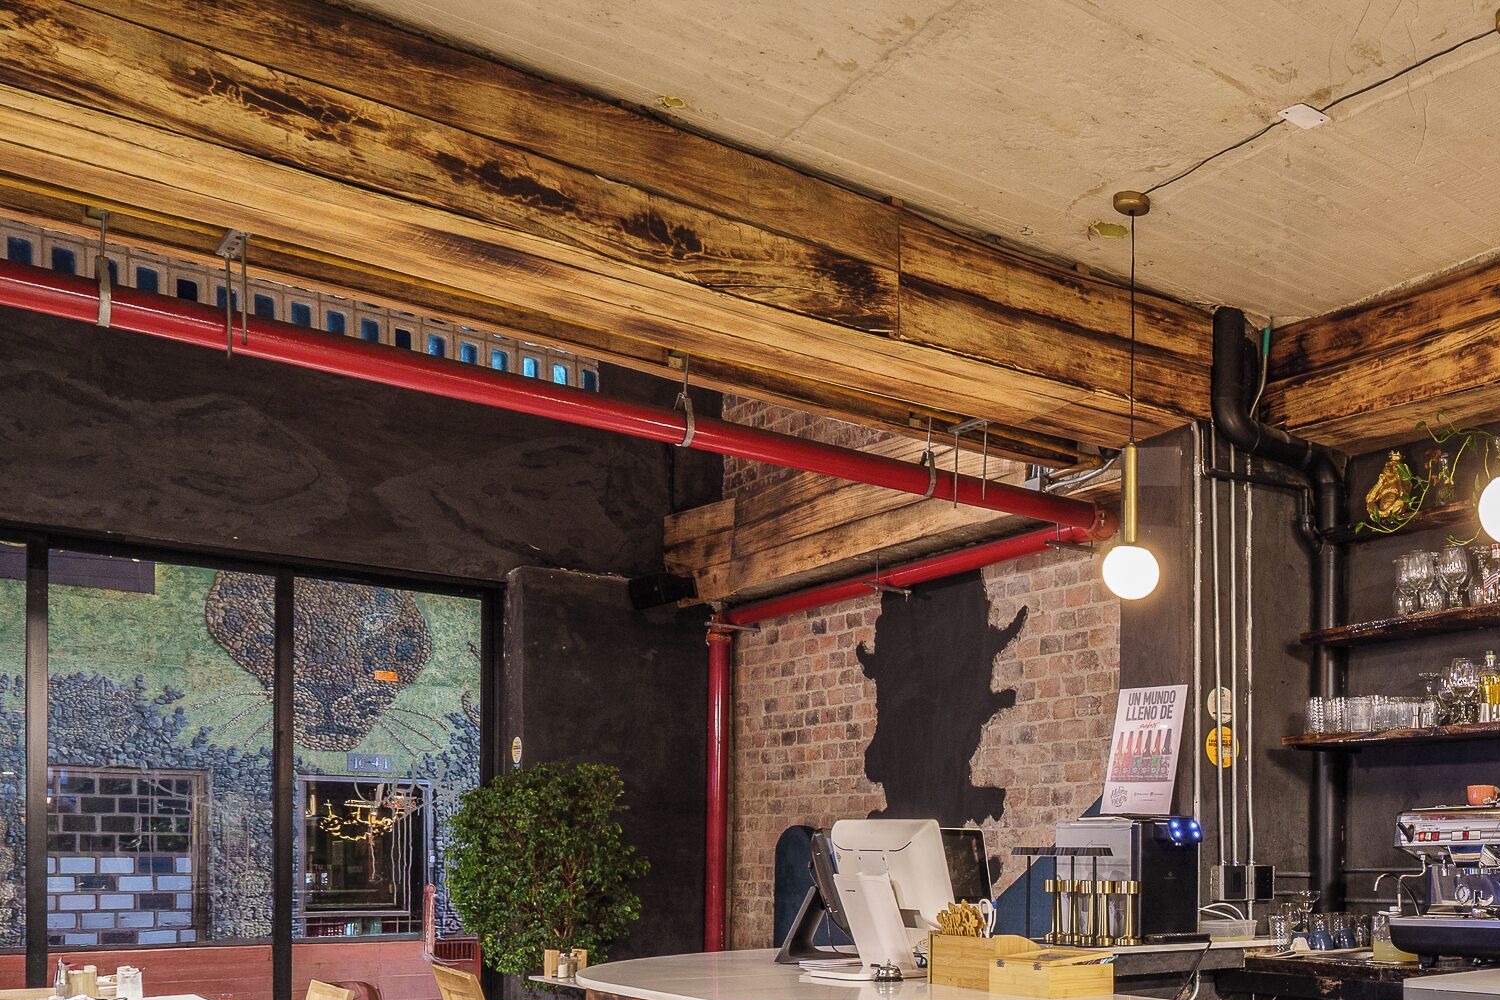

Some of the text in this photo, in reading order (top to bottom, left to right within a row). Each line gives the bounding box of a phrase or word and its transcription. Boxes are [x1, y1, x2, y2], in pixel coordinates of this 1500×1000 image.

[1128, 690, 1176, 706] UN MUNDO
[1126, 704, 1174, 720] LLENO DE
